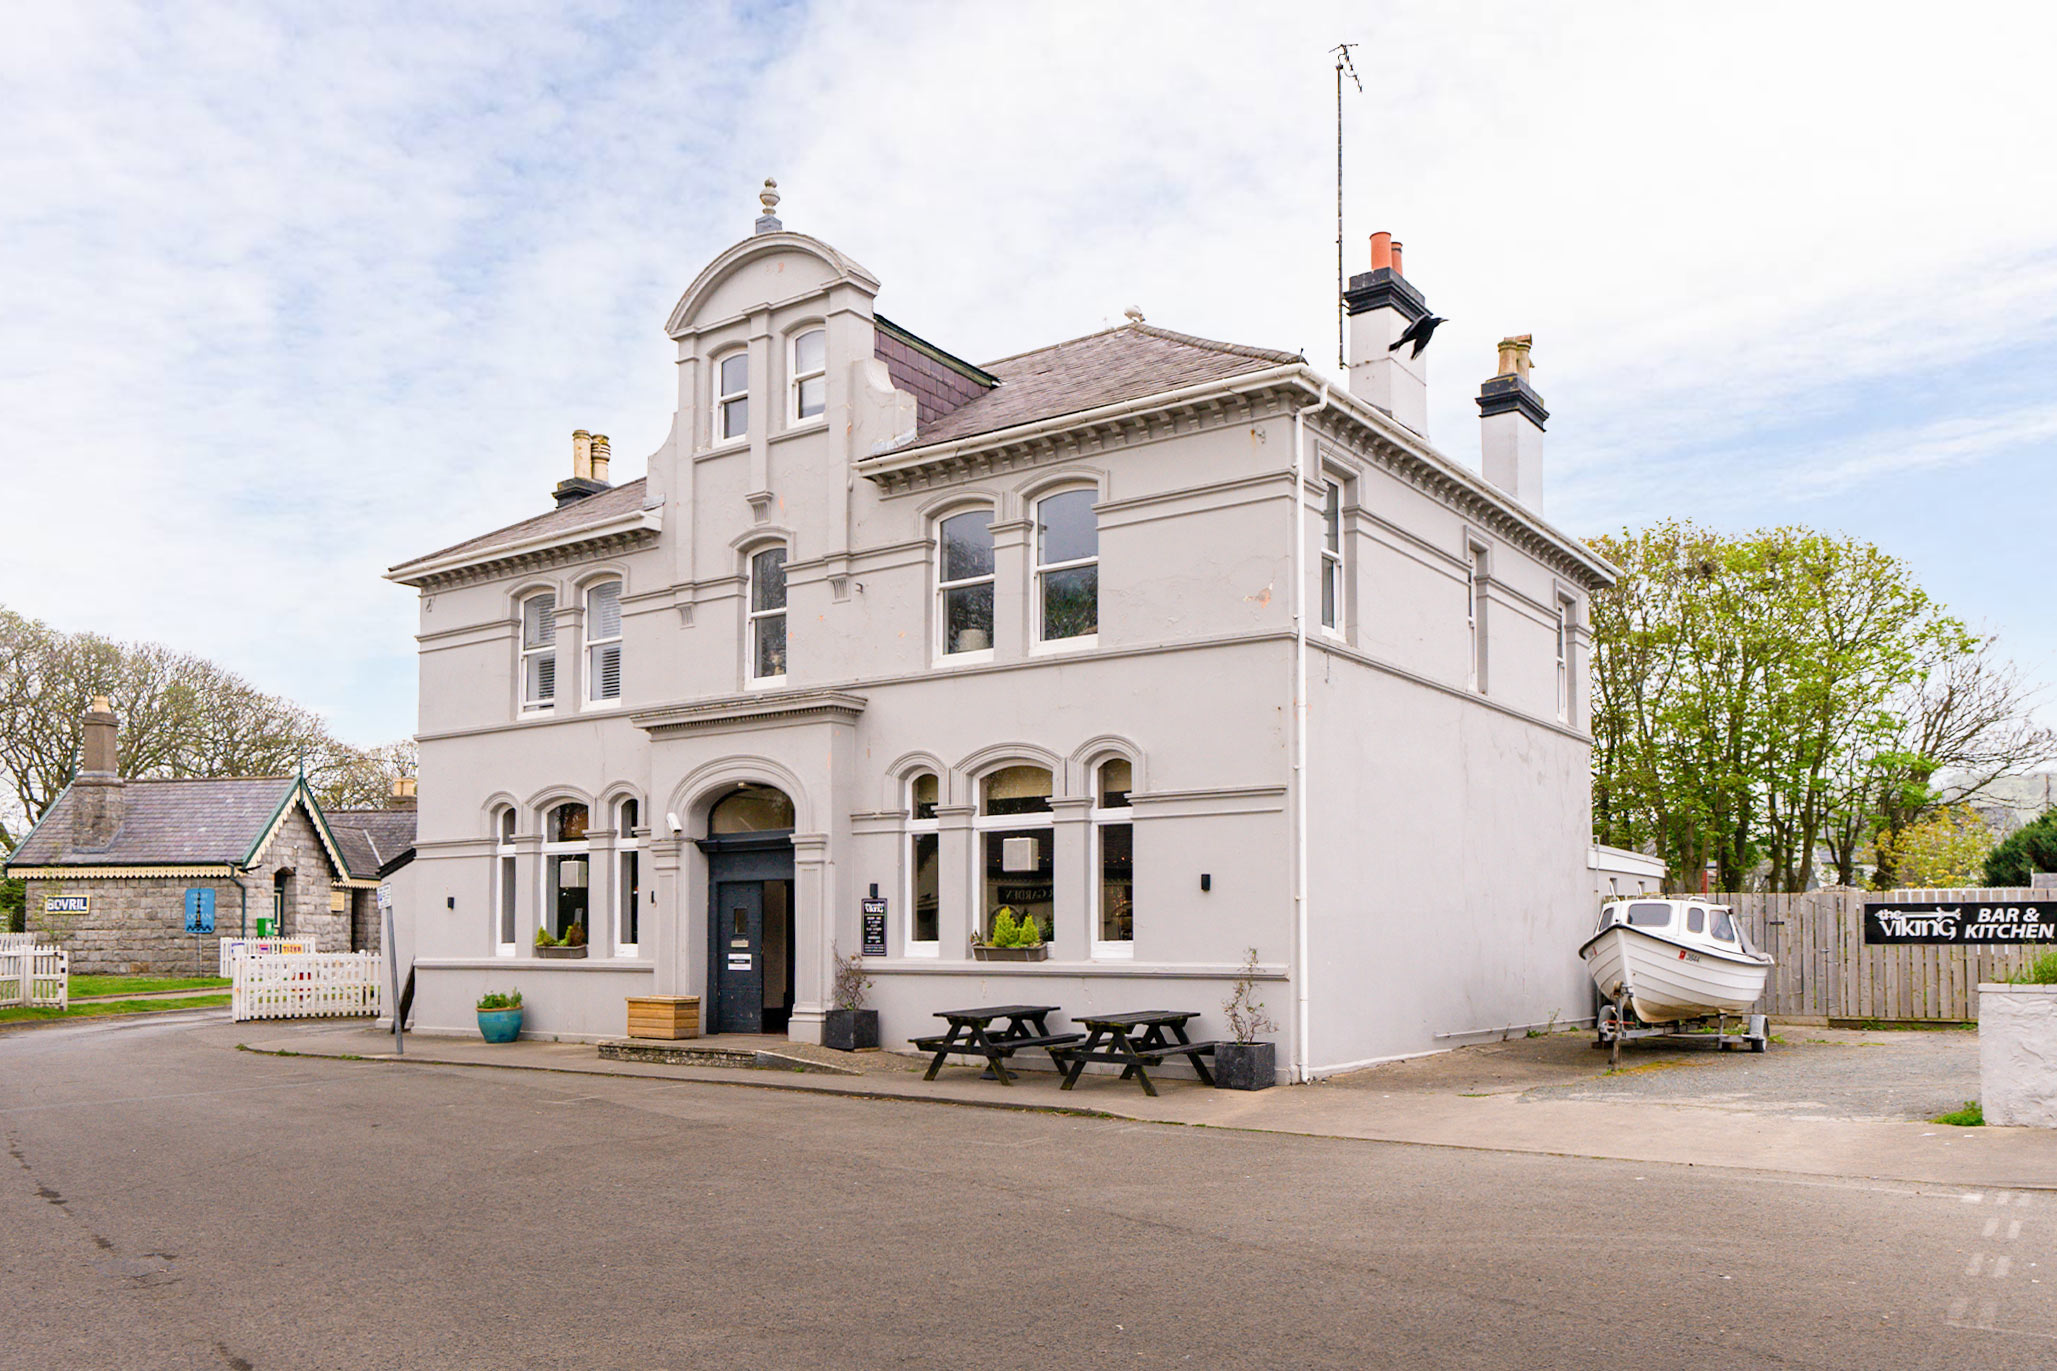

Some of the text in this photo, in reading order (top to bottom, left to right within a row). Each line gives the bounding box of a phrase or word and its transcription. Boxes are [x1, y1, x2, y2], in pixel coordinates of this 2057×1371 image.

[47, 898, 87, 910] BOVRIL
[1879, 909, 1902, 920] the
[1977, 907, 2040, 923] BAR &
[1964, 923, 2055, 939] KITCHEN
